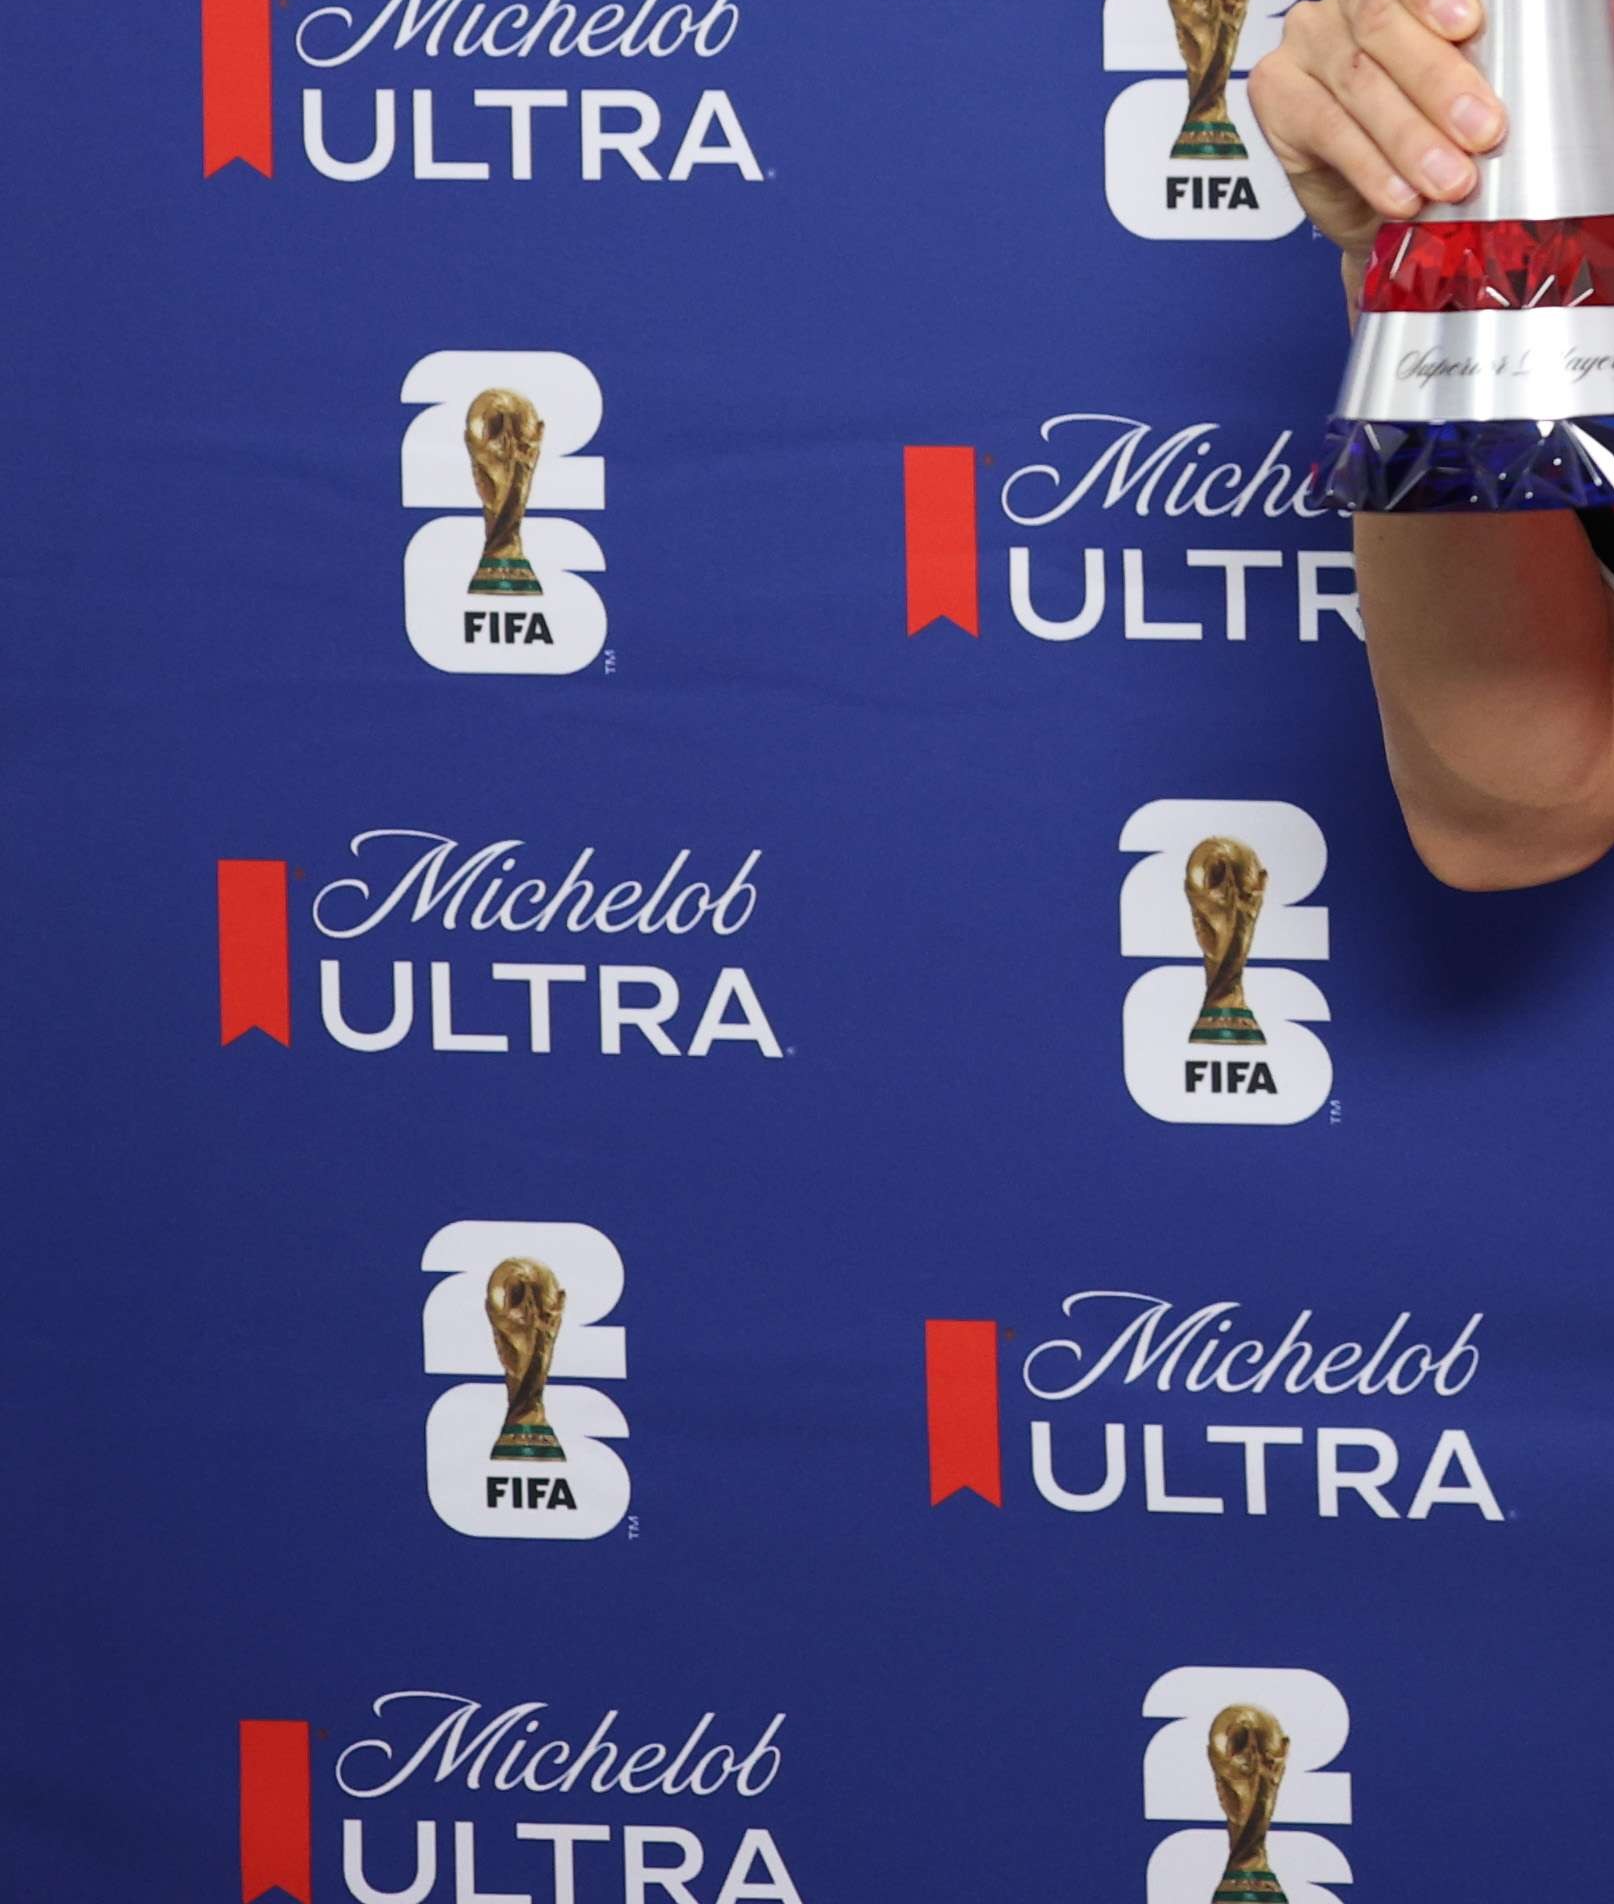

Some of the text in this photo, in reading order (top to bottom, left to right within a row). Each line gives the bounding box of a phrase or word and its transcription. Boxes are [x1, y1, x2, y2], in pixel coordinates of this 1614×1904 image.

[302, 88, 765, 182] ULTRA
[1166, 176, 1260, 210] FIFA
[1397, 345, 1509, 389] Superir
[1001, 413, 1352, 526] Miche
[464, 611, 554, 645] FIFA
[1009, 546, 1367, 642] ULTR
[312, 829, 763, 939] Michelob
[320, 959, 784, 1058] ULTRA
[1185, 1060, 1278, 1095] FIFA
[1022, 1290, 1484, 1400] Michelob
[486, 1476, 577, 1510] FIFA
[1030, 1420, 1505, 1521] ULTRA
[335, 1690, 787, 1798] Michelob
[343, 1818, 803, 1904] ULTRA
